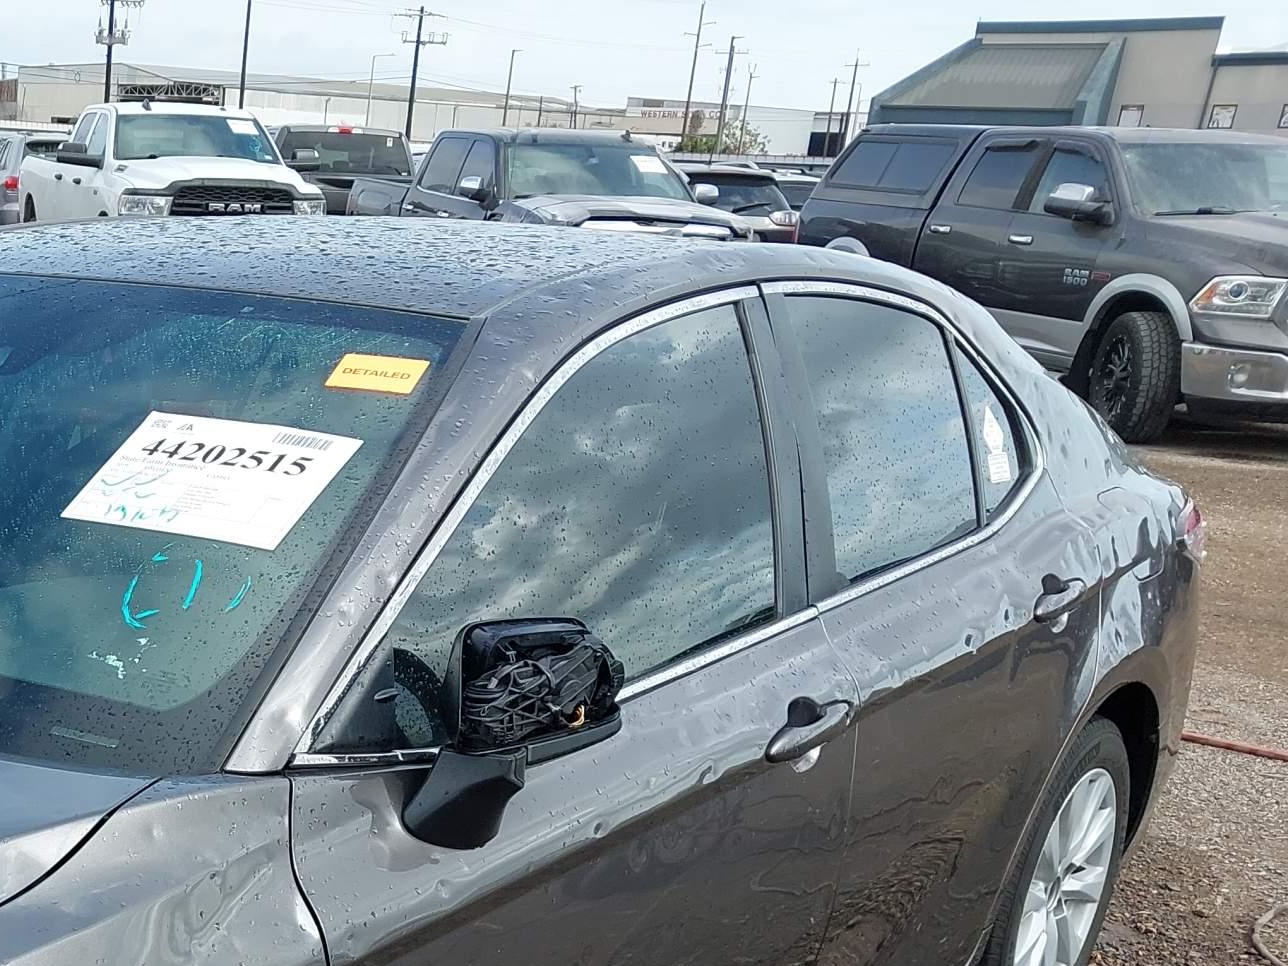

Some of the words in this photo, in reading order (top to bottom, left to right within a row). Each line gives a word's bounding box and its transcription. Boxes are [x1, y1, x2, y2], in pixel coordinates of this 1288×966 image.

[640, 110, 678, 119] WESTERN
[208, 203, 262, 212] RAM
[1064, 268, 1089, 277] RAM
[1063, 276, 1088, 286] 1500
[342, 367, 411, 380] DETAILED
[141, 438, 314, 476] 44202515
